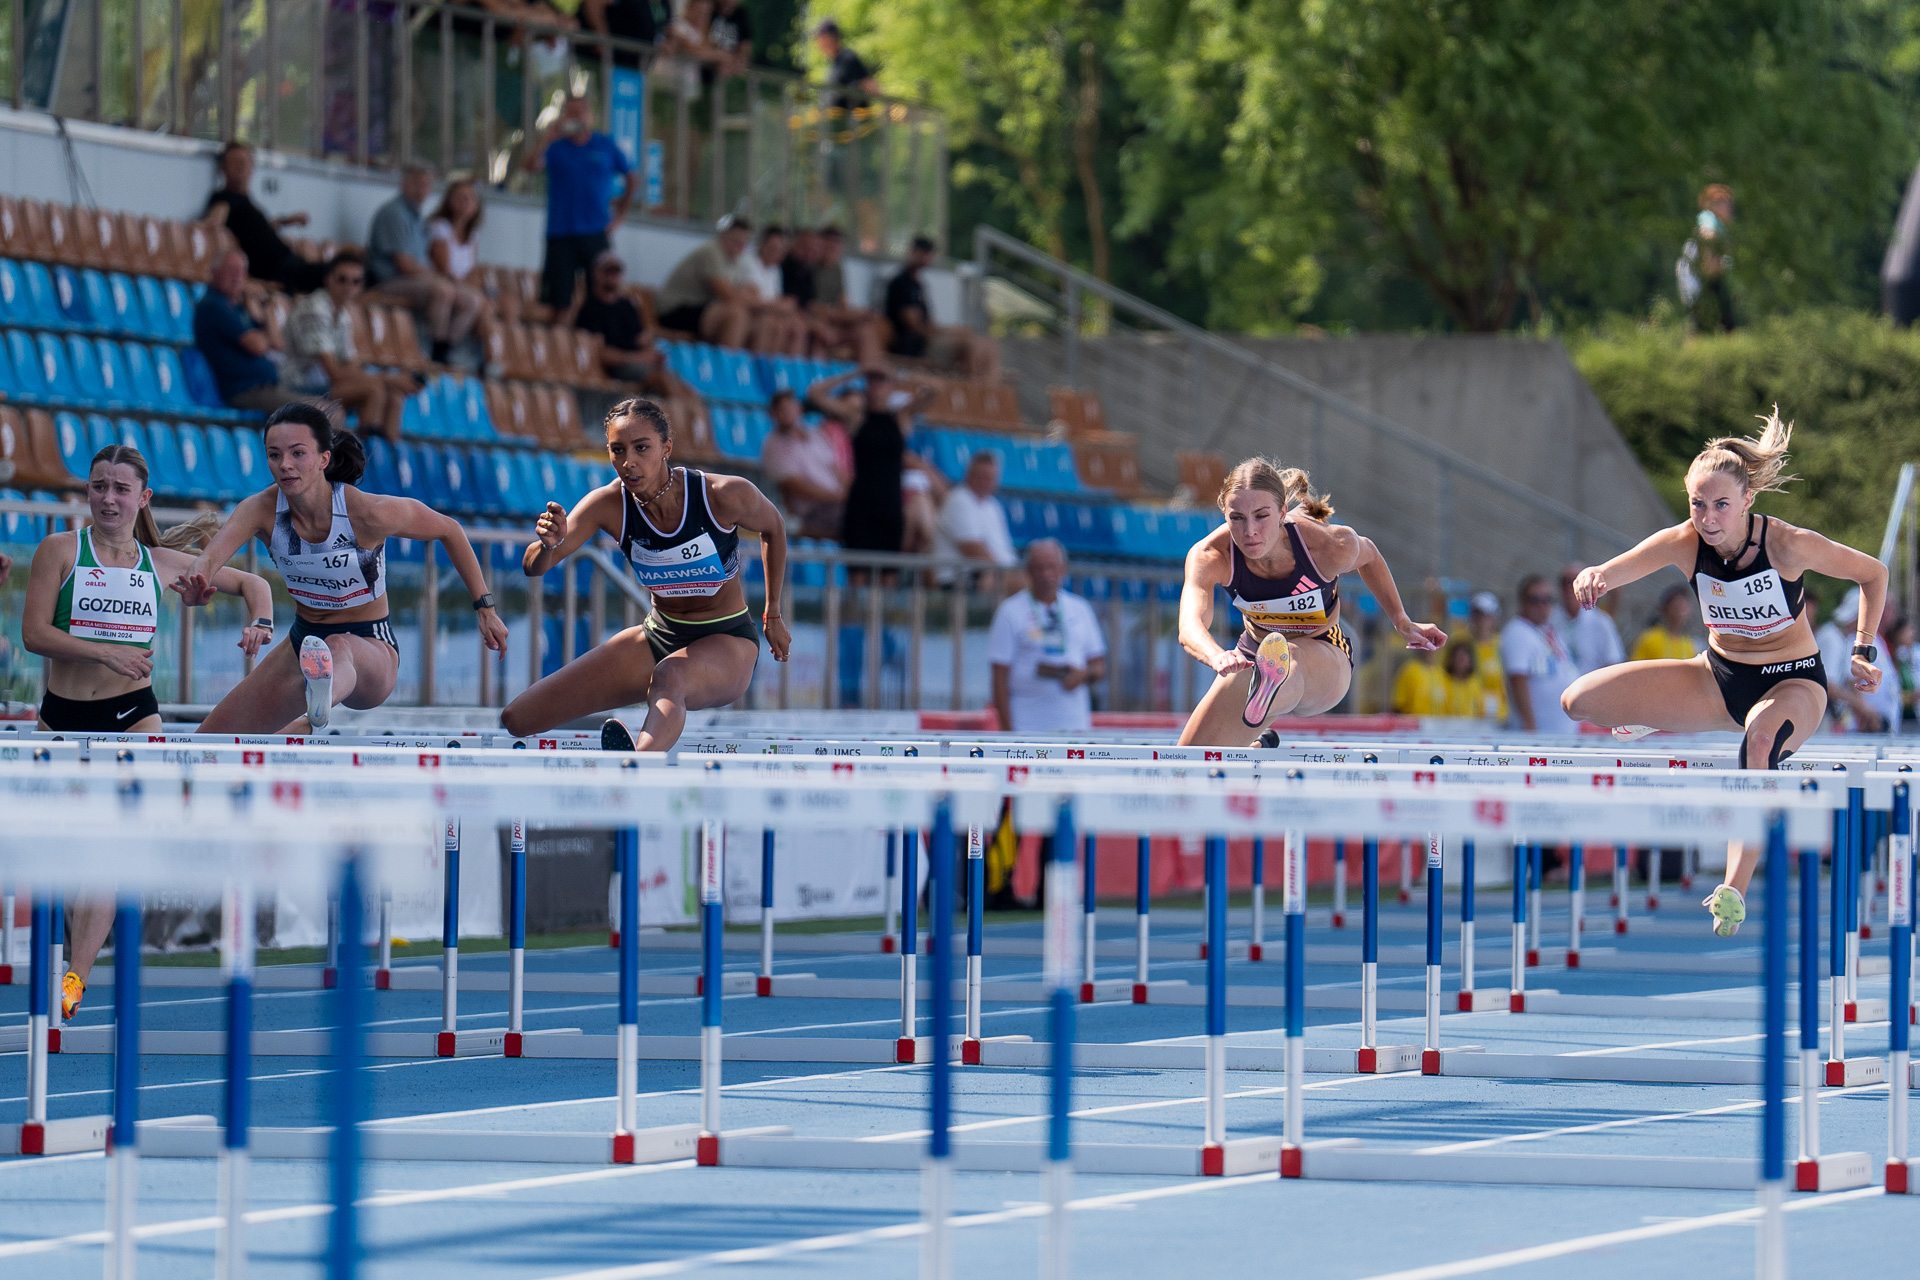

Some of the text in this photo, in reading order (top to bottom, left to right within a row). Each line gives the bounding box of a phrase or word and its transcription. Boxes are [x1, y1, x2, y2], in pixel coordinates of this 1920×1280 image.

[332, 540, 353, 550] adidas
[681, 544, 702, 560] 82
[322, 554, 349, 568] 167
[638, 565, 720, 580] MAJEWSKA
[130, 574, 144, 587] 56
[286, 575, 359, 590] SZCZĘSNA
[1744, 575, 1772, 595] 185
[79, 598, 152, 616] GOZDERA
[1288, 596, 1316, 611] 182
[1708, 604, 1781, 620] SIELSKA
[1761, 658, 1816, 674] NIKE PRO
[834, 748, 861, 757] UMCS
